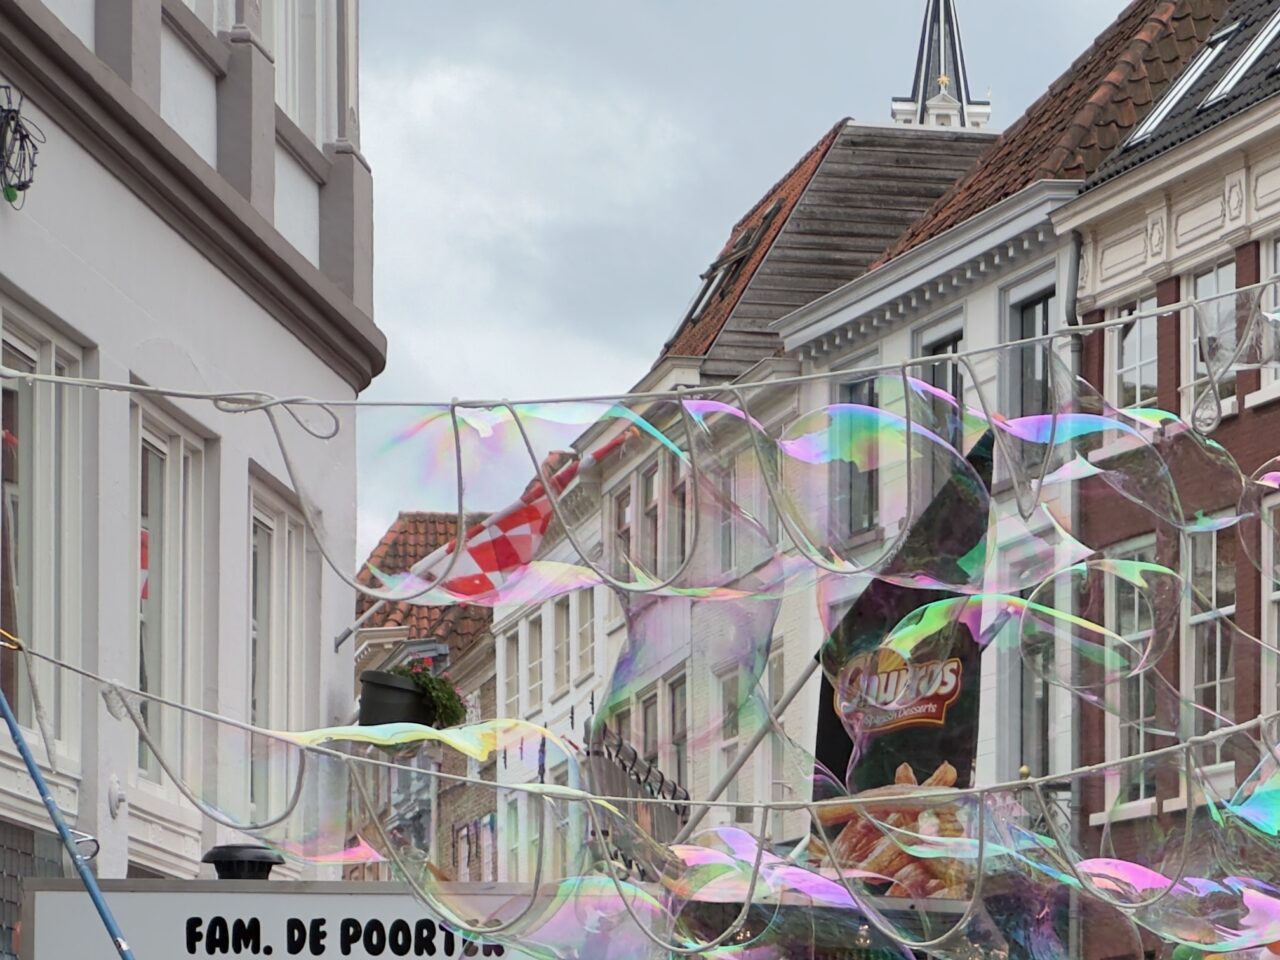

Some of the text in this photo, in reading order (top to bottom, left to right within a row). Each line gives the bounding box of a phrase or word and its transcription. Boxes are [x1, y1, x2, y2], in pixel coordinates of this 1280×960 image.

[839, 652, 957, 712] Churros
[186, 917, 273, 955] FAM.
[286, 918, 327, 955] DE
